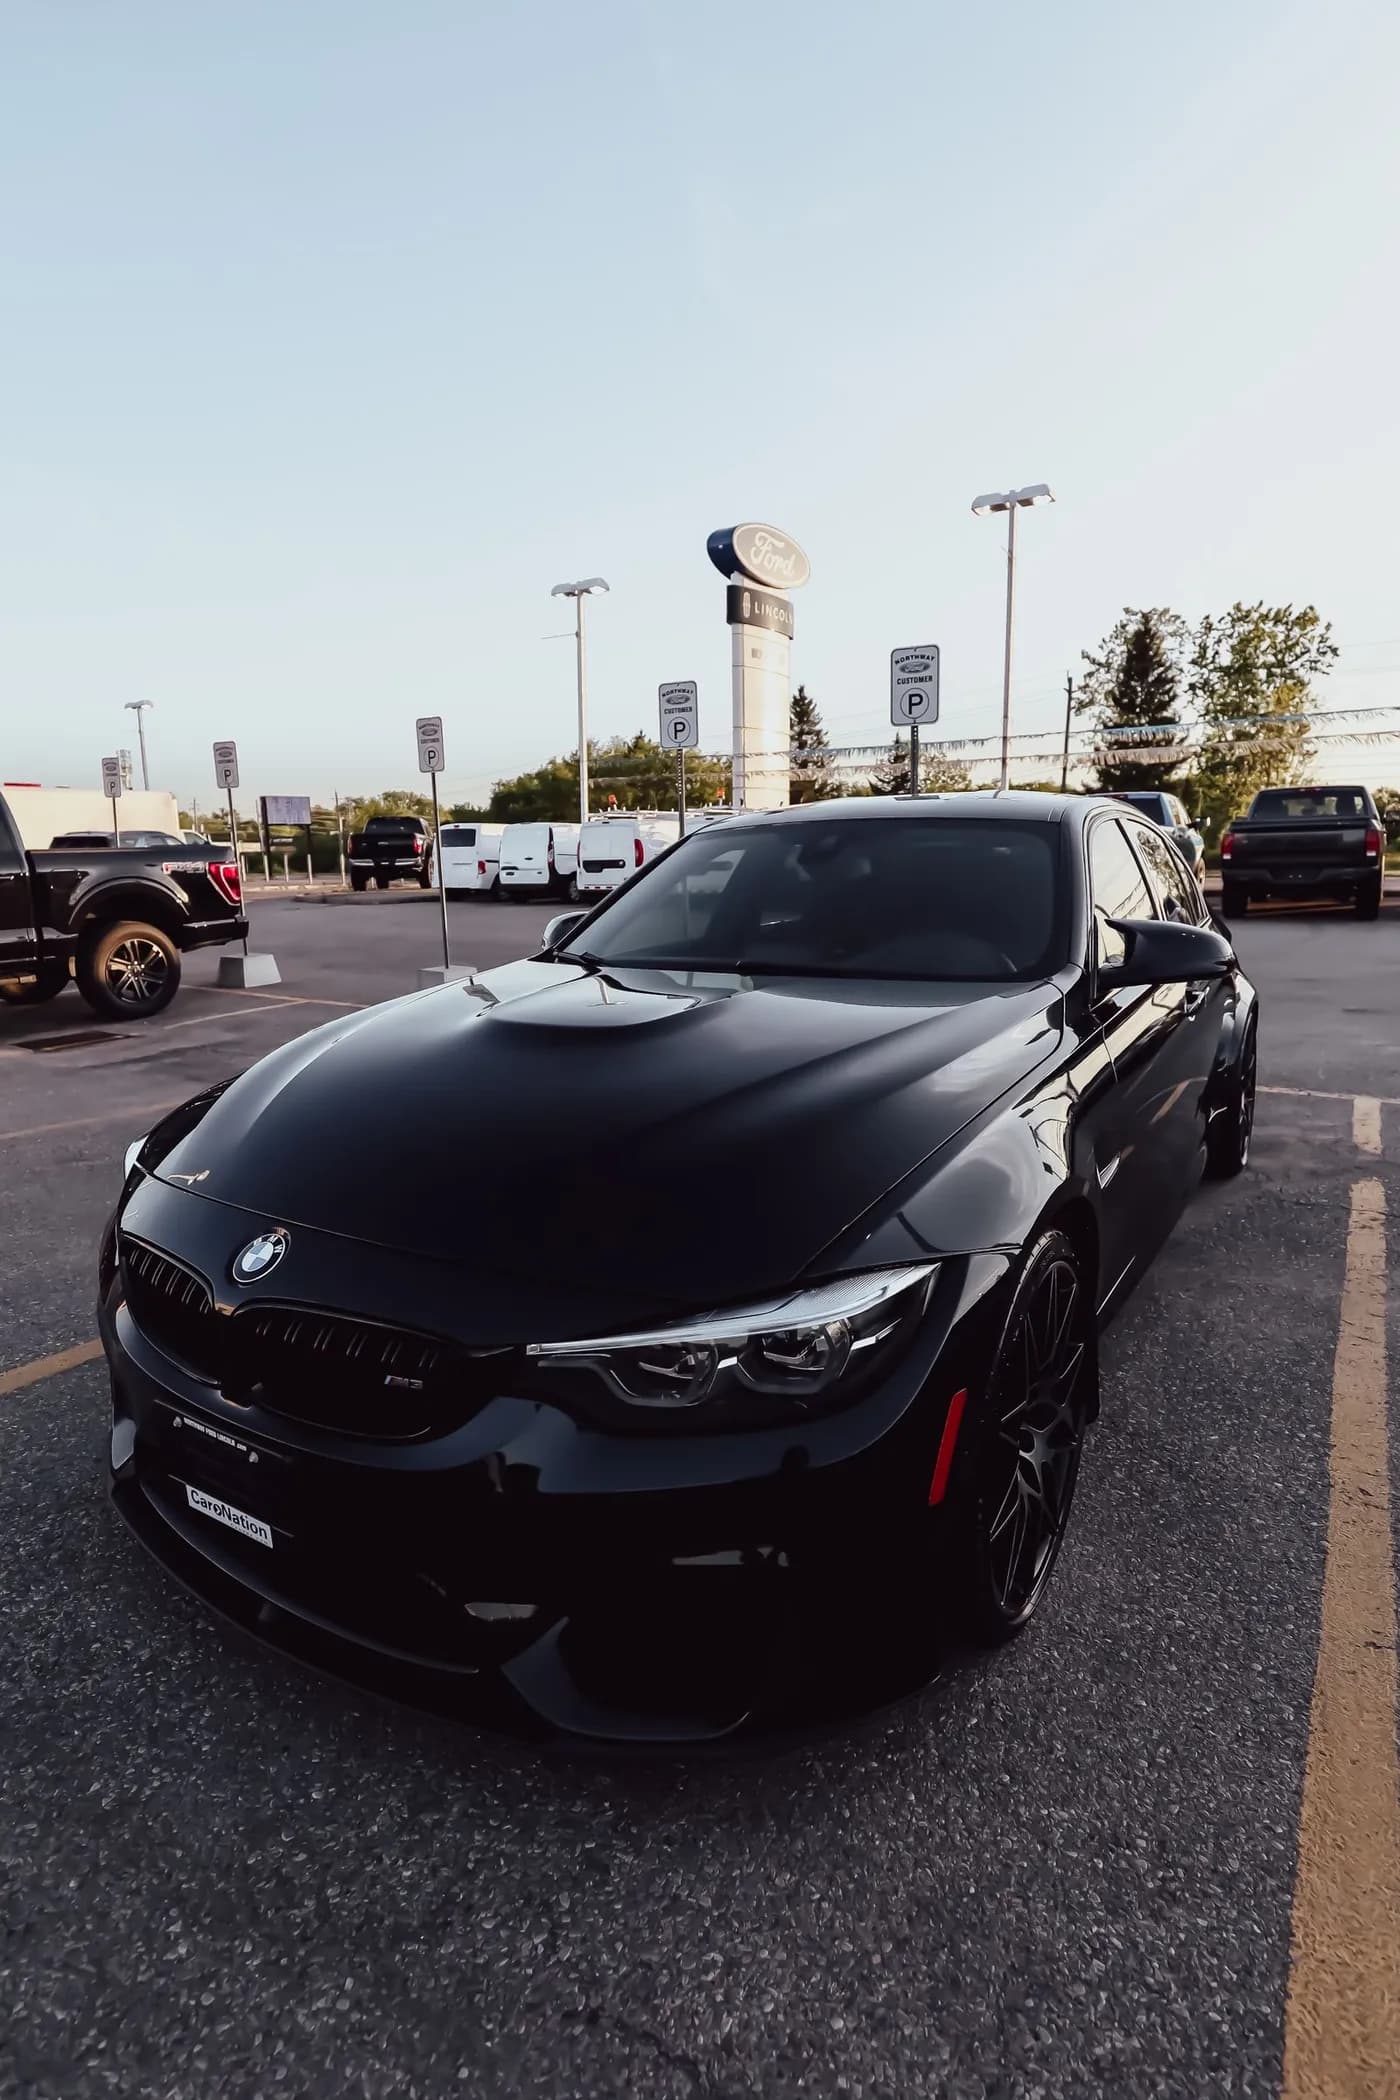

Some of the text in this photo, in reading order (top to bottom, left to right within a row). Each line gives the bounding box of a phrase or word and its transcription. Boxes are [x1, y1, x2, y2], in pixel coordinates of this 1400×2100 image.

[750, 531, 797, 576] Ford
[895, 654, 936, 665] NORTHWAY
[896, 675, 933, 685] CUSTOMER
[908, 693, 924, 715] P
[673, 721, 686, 740] P
[427, 749, 437, 765] P
[223, 769, 232, 782] P
[109, 781, 116, 793] P
